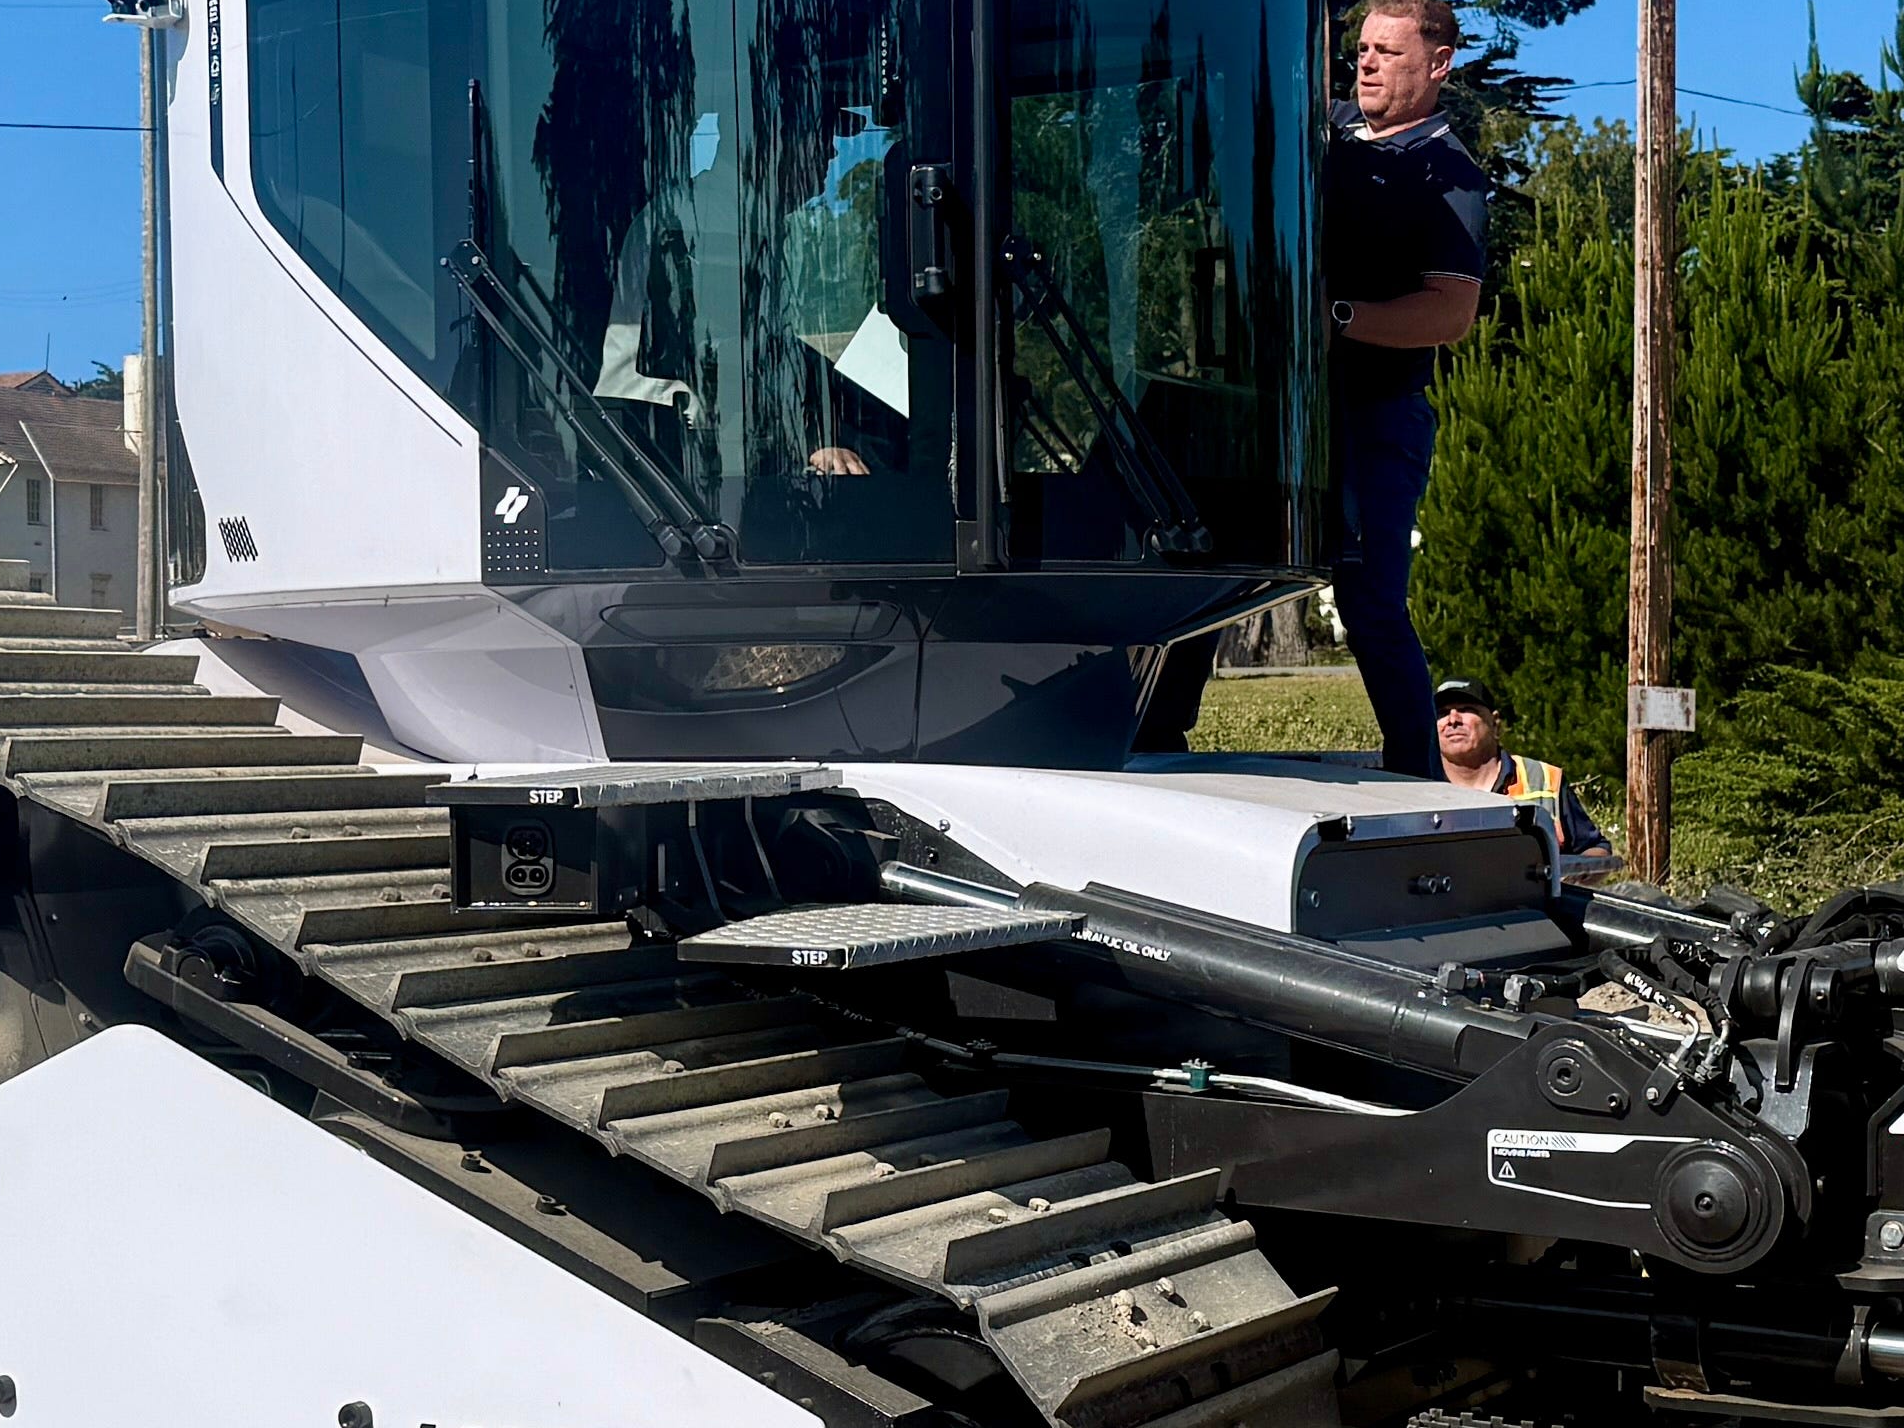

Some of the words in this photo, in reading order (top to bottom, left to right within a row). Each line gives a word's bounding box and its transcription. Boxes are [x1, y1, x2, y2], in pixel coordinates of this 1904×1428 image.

[529, 789, 564, 804] STEP
[792, 949, 828, 965] STEP
[1123, 940, 1141, 955] OIL
[1141, 945, 1172, 962] ONLY
[1494, 1133, 1549, 1146] CAUTION
